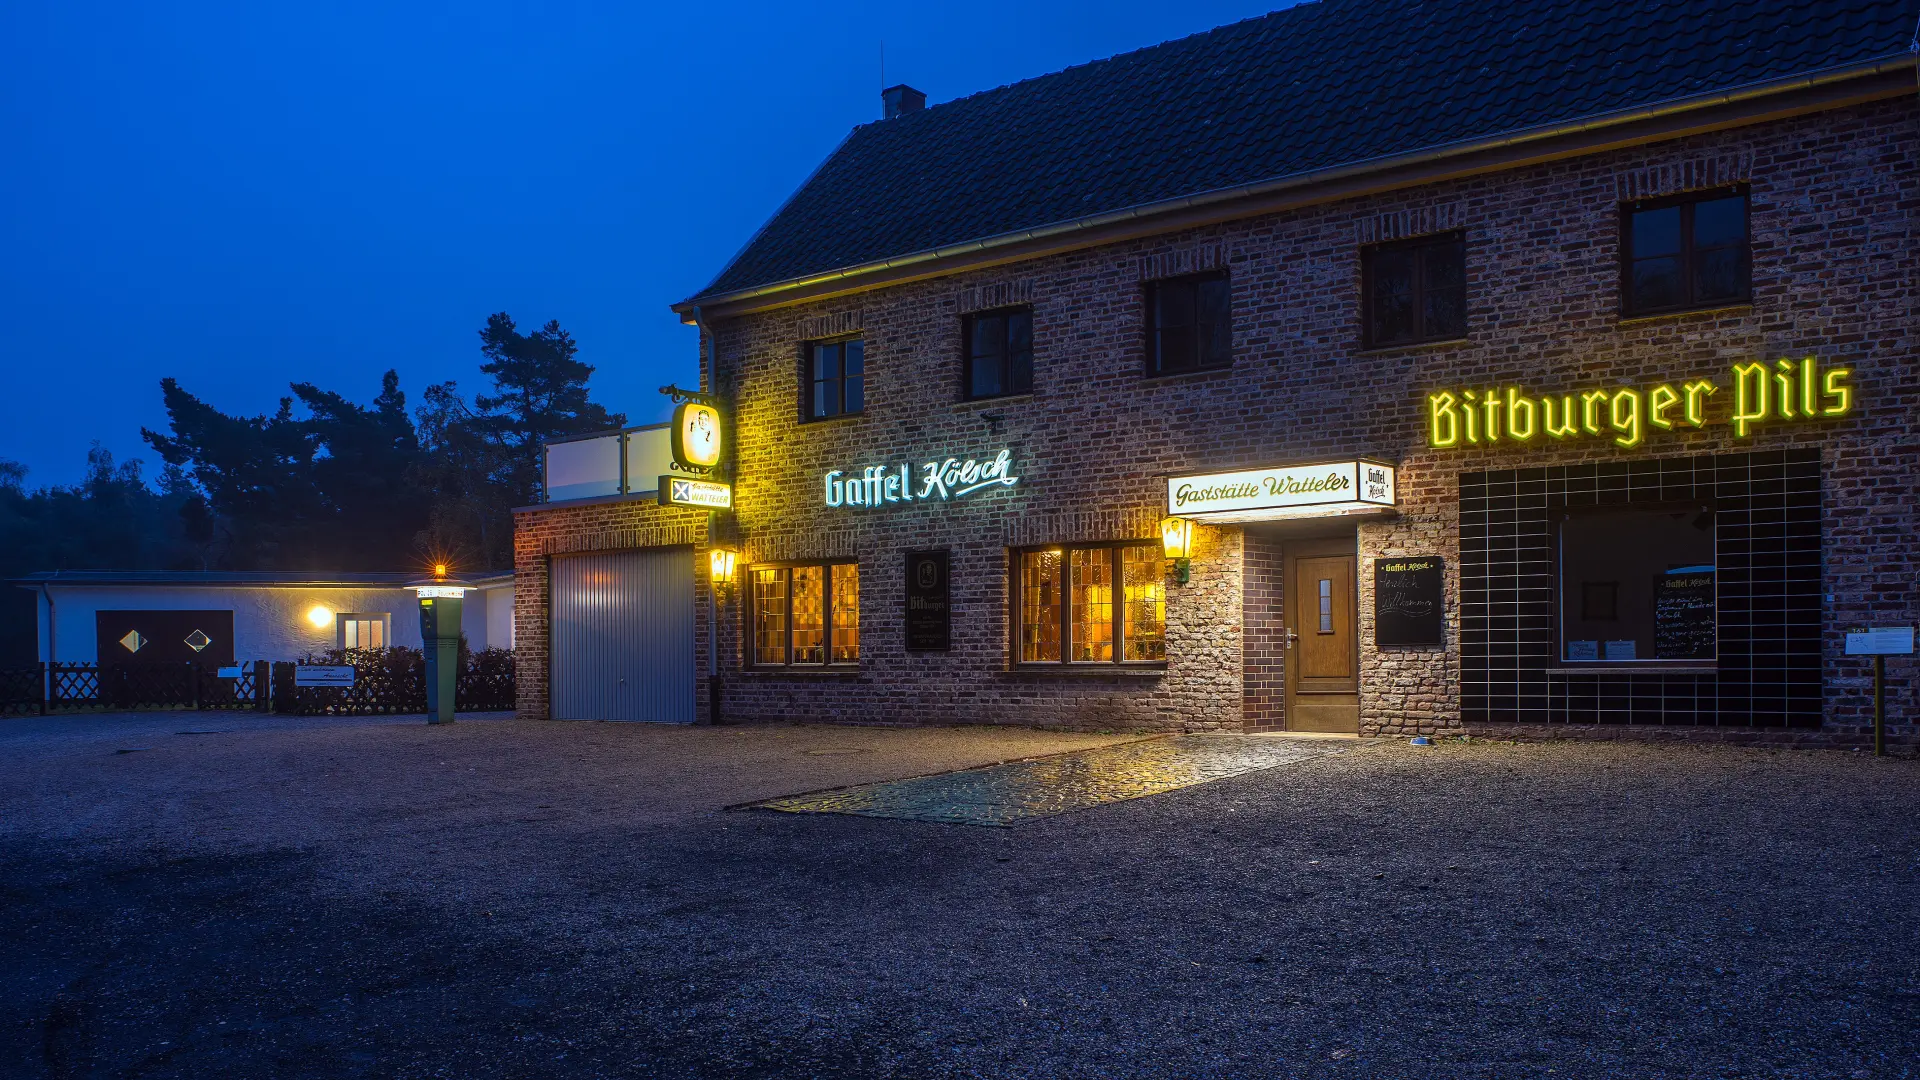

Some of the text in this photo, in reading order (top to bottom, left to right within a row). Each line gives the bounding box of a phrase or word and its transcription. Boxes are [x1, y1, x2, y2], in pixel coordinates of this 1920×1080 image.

[1429, 355, 1853, 449] Bitburger Pils
[825, 449, 1019, 508] Gaffel Kölsch
[1368, 468, 1386, 485] Gaffel
[1176, 472, 1350, 507] Gaststätte Watteler
[691, 493, 729, 504] WATTELER
[1385, 563, 1407, 572] Gaffel
[1665, 578, 1687, 588] Gaffel
[1382, 592, 1432, 609] Willkommen
